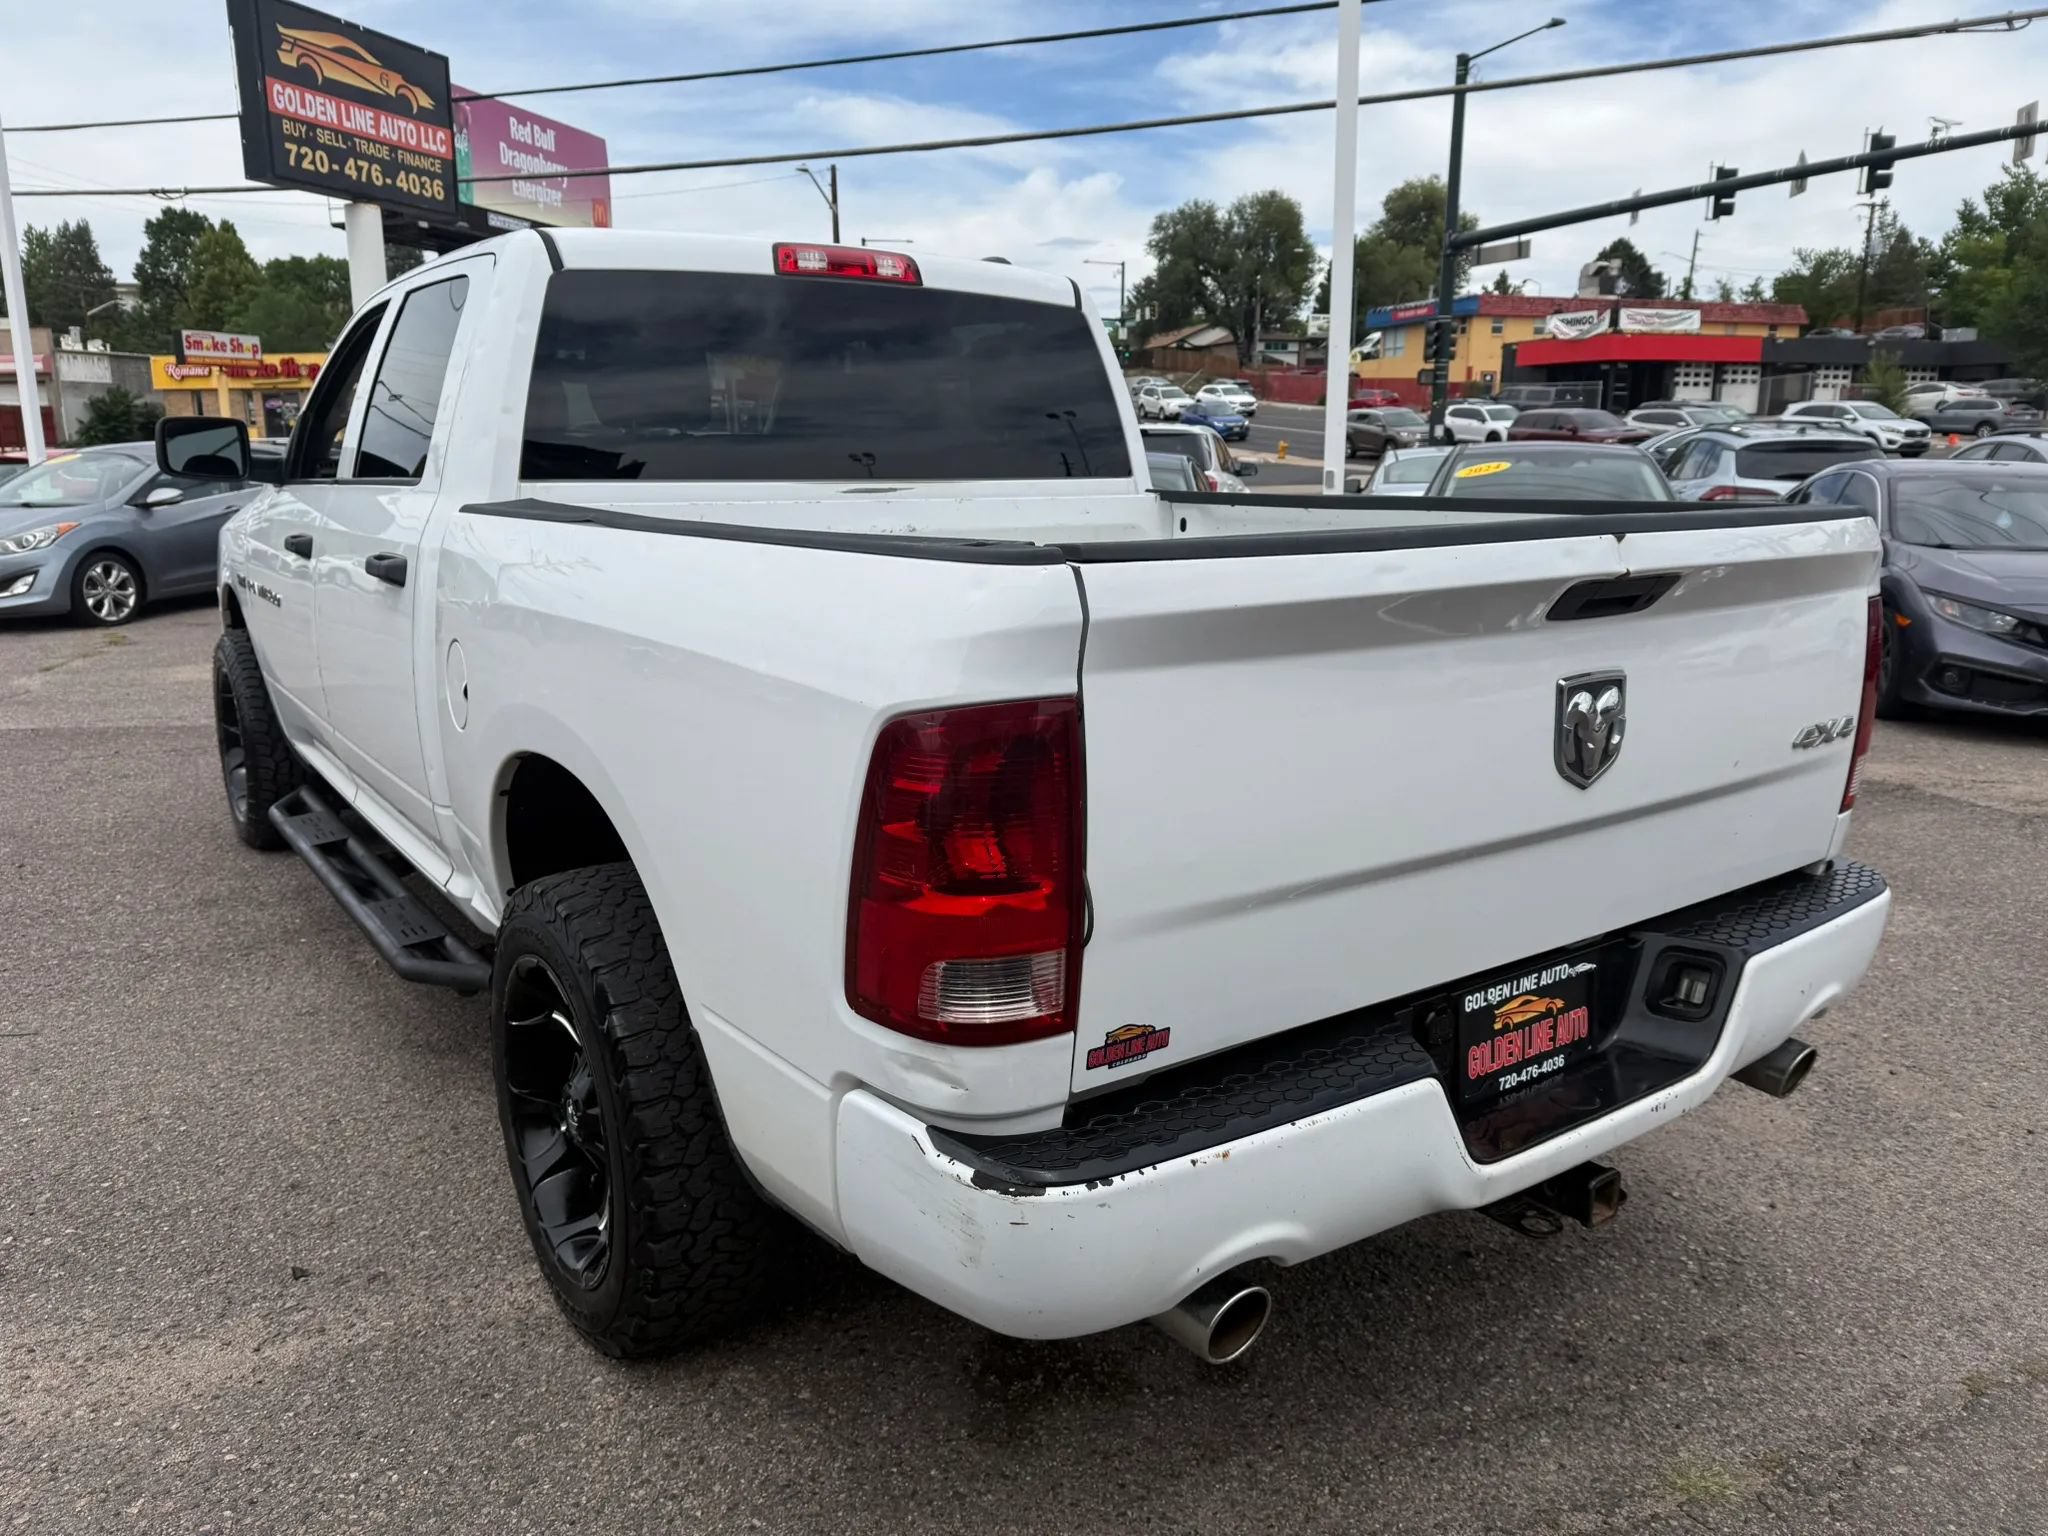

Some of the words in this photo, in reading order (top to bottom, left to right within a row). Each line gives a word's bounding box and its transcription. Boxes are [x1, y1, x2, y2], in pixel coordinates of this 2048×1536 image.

[272, 83, 338, 125] GOLDEN
[341, 103, 376, 135] LINE
[380, 115, 417, 146] AUTO
[420, 126, 447, 154] LLC
[509, 116, 532, 145] Red
[533, 124, 557, 153] Bull
[282, 119, 308, 139] BUY
[316, 128, 347, 149] SELL
[353, 137, 391, 160] TRADE
[397, 150, 443, 174] FINANCE
[512, 179, 563, 211] Energizer
[185, 334, 227, 352] Smoke
[230, 336, 260, 360] Shop
[165, 364, 209, 380] Romance
[1512, 973, 1539, 996] LINE
[1539, 963, 1570, 988] AUTO
[1088, 1042, 1125, 1068] GOLDEN
[1125, 1035, 1146, 1056] LINE
[1147, 1029, 1169, 1050] AUTO
[1468, 1029, 1523, 1079] GOLDEN
[1524, 1018, 1554, 1059] LINE
[1556, 1006, 1589, 1048] AUTO
[1499, 1054, 1565, 1092] 720-476-4036
